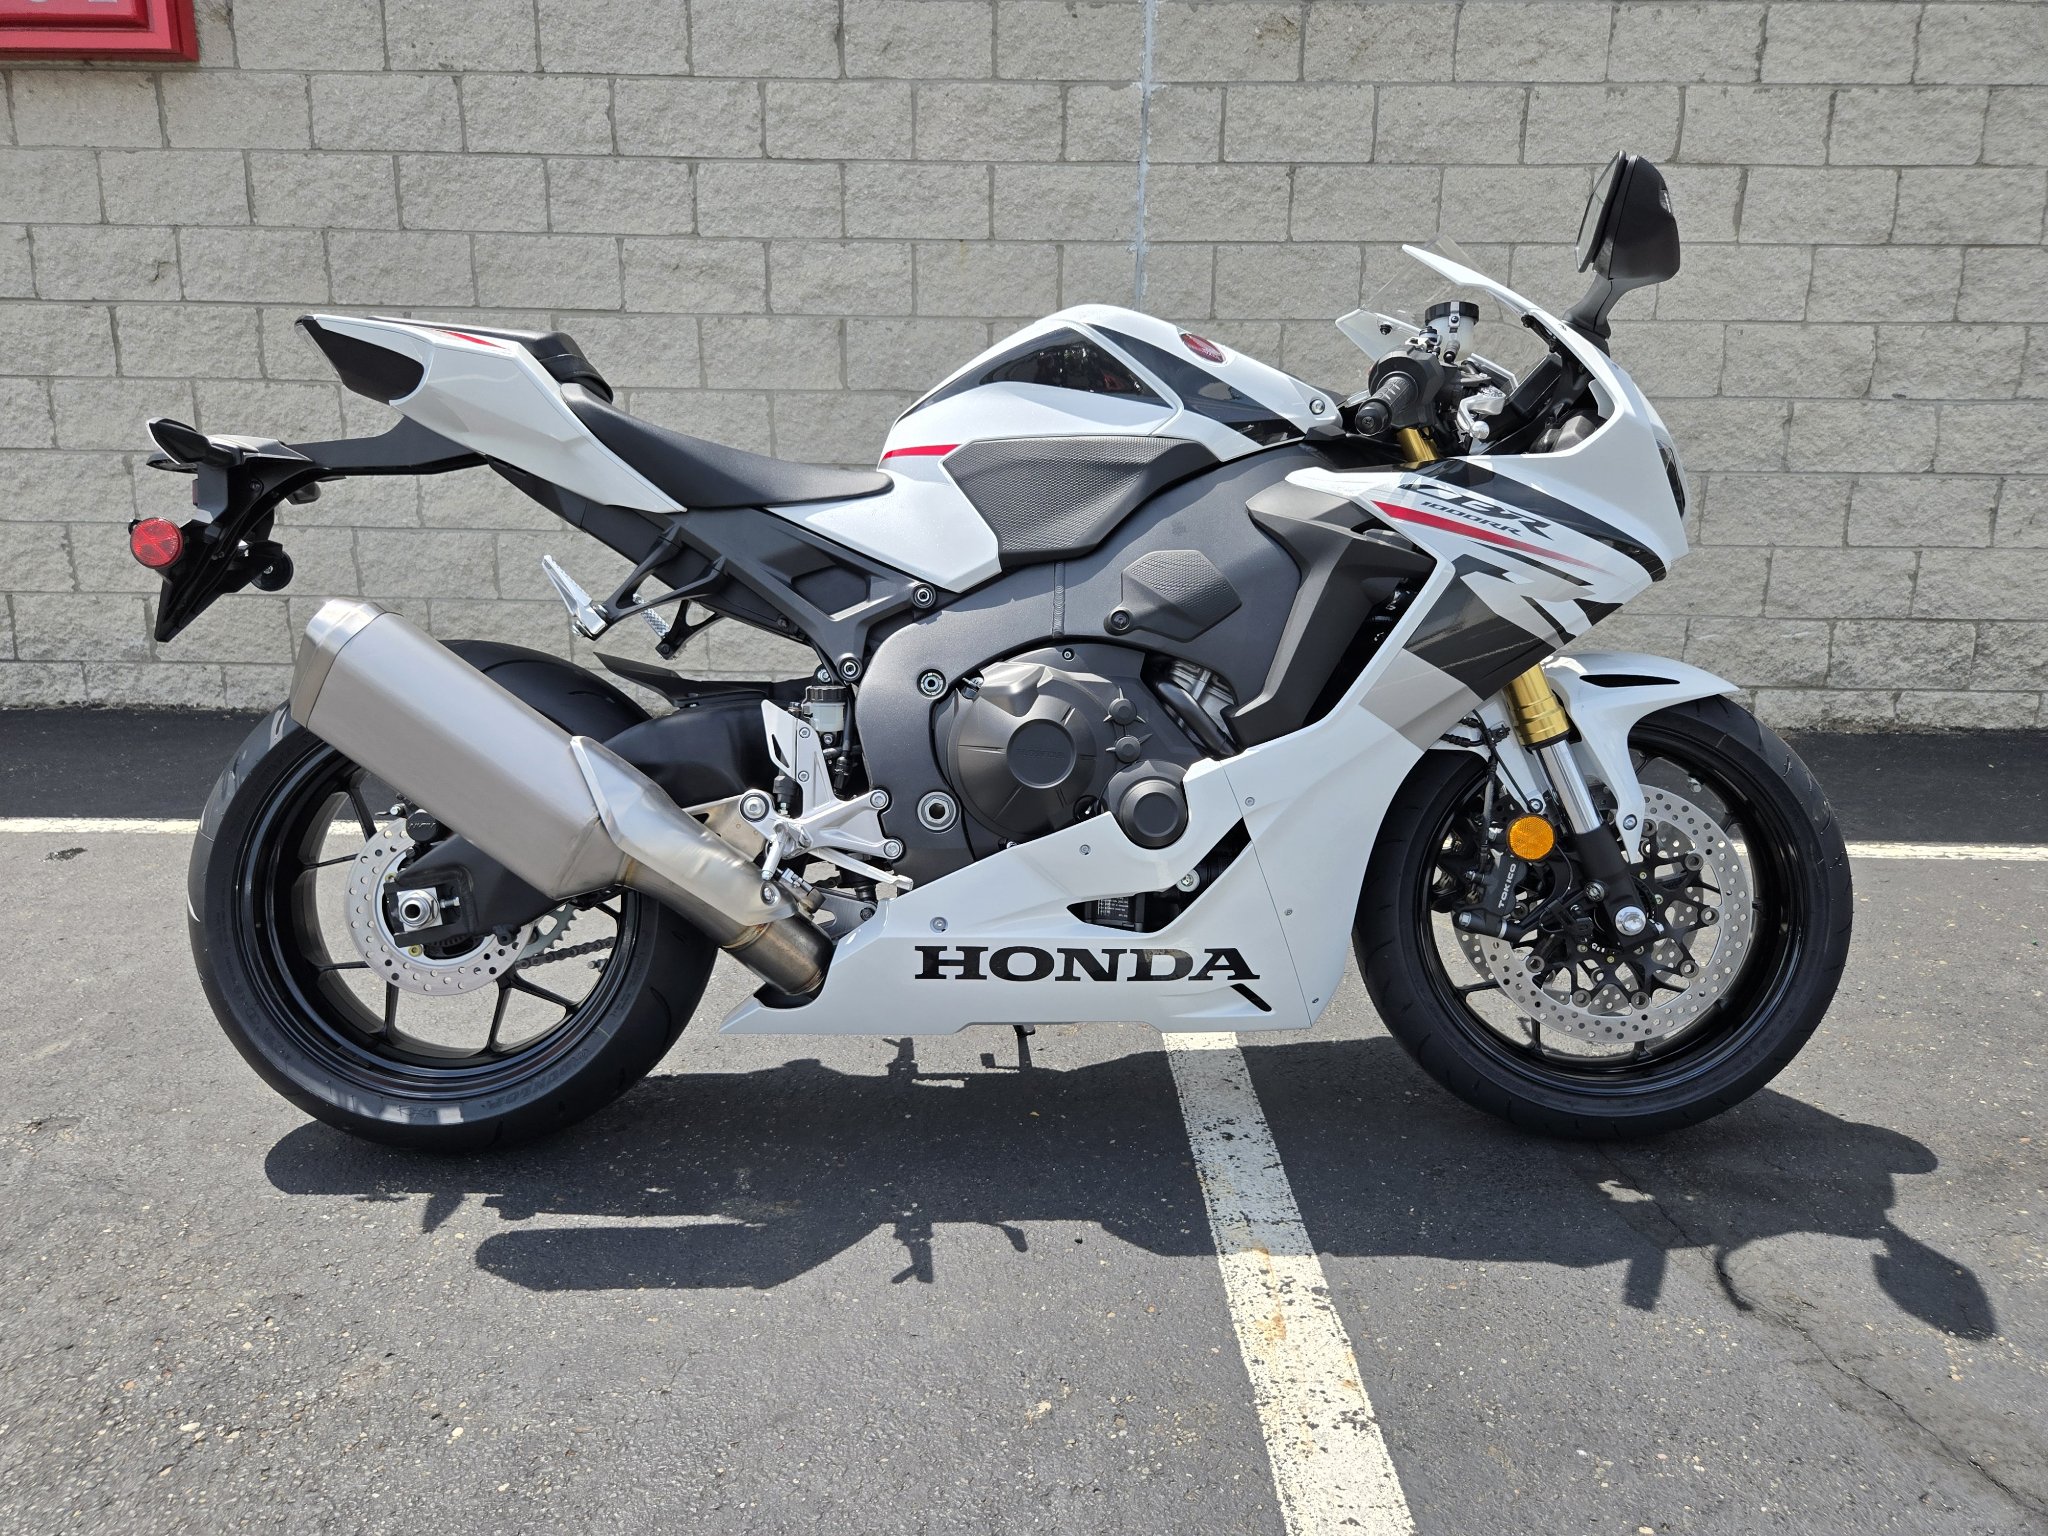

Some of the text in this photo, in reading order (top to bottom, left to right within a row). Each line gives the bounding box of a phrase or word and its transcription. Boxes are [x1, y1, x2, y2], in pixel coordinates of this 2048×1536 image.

[1397, 484, 1554, 541] CBR
[1420, 501, 1522, 537] 1000RR
[1498, 863, 1517, 908] TOKICO
[914, 945, 1261, 982] HONDA
